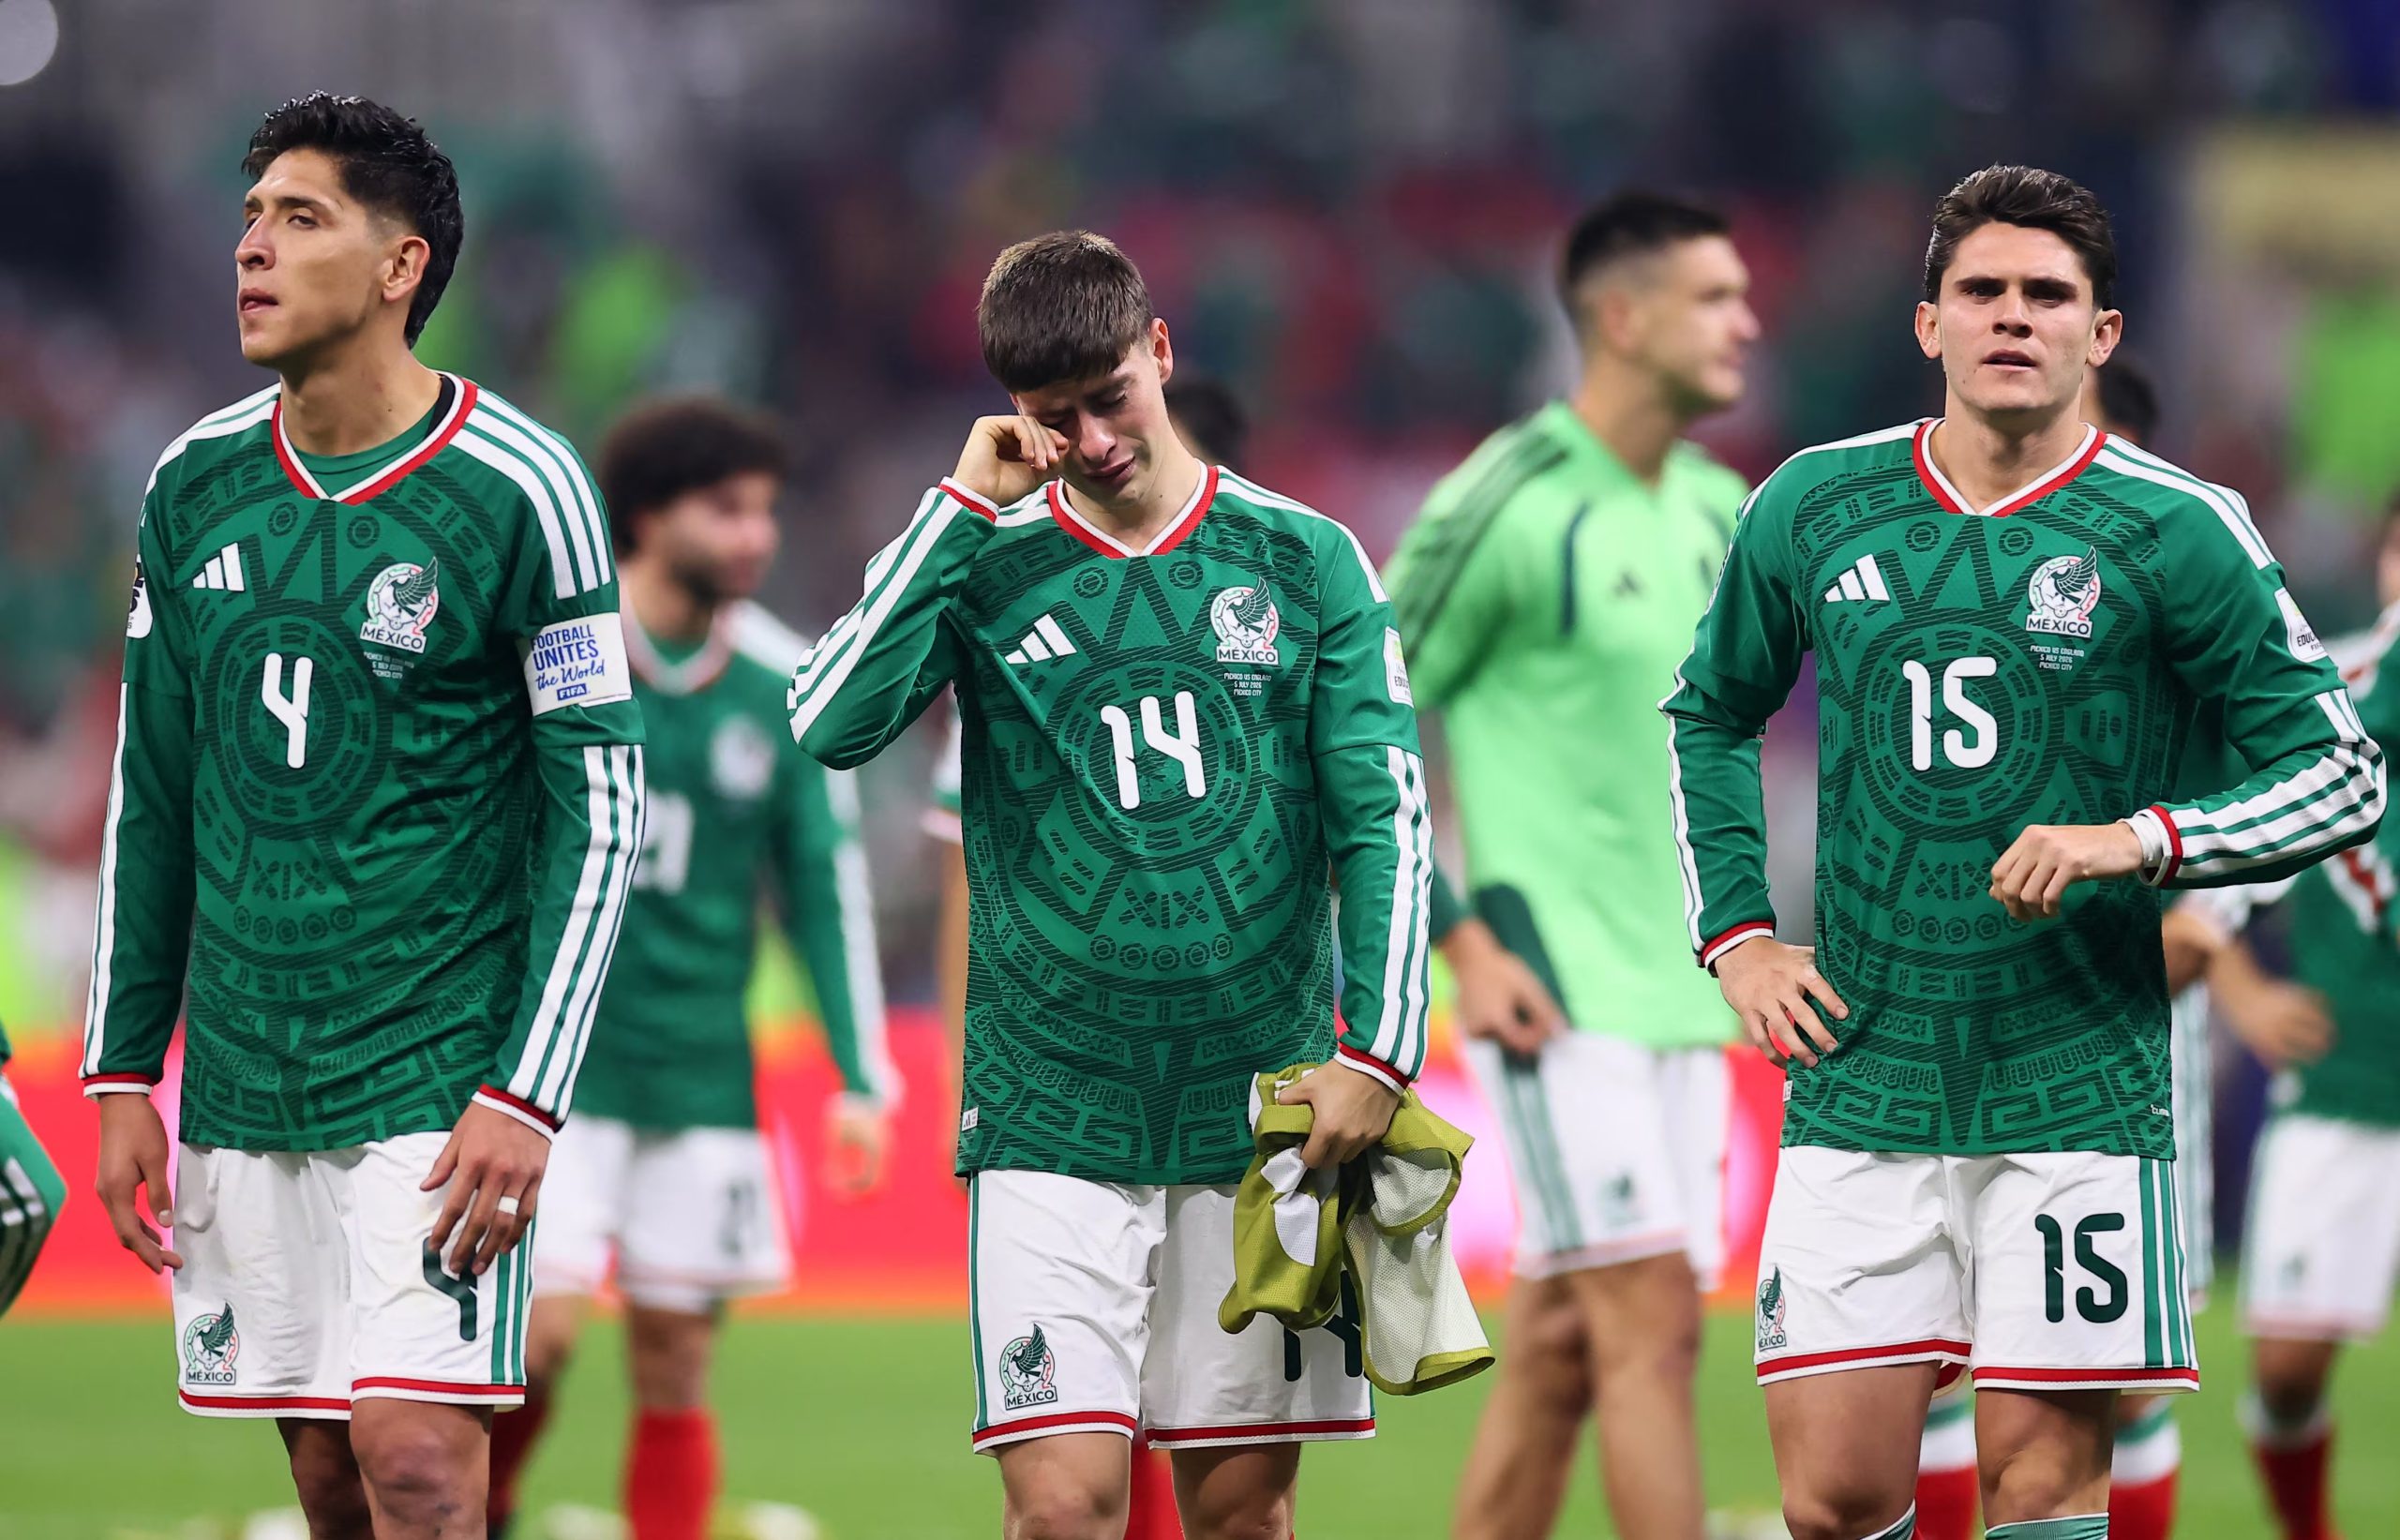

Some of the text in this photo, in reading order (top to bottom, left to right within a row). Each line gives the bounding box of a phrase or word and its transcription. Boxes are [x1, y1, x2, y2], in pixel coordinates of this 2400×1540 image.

[362, 626, 423, 649] MÉXICO
[531, 624, 594, 650] FOOTBALL
[2028, 616, 2090, 635] MÉXICO
[532, 639, 599, 671] UNITES
[1219, 647, 1276, 662] MÉXICO
[534, 659, 605, 692] the World
[558, 685, 586, 699] FIFA
[262, 651, 312, 770] 4
[1902, 656, 1999, 772] 15
[1100, 691, 1206, 810] 14
[2034, 1213, 2127, 1323] 15
[423, 1236, 477, 1340] 4
[188, 1369, 233, 1383] MÉXICO
[1007, 1390, 1055, 1407] MÉXICO
